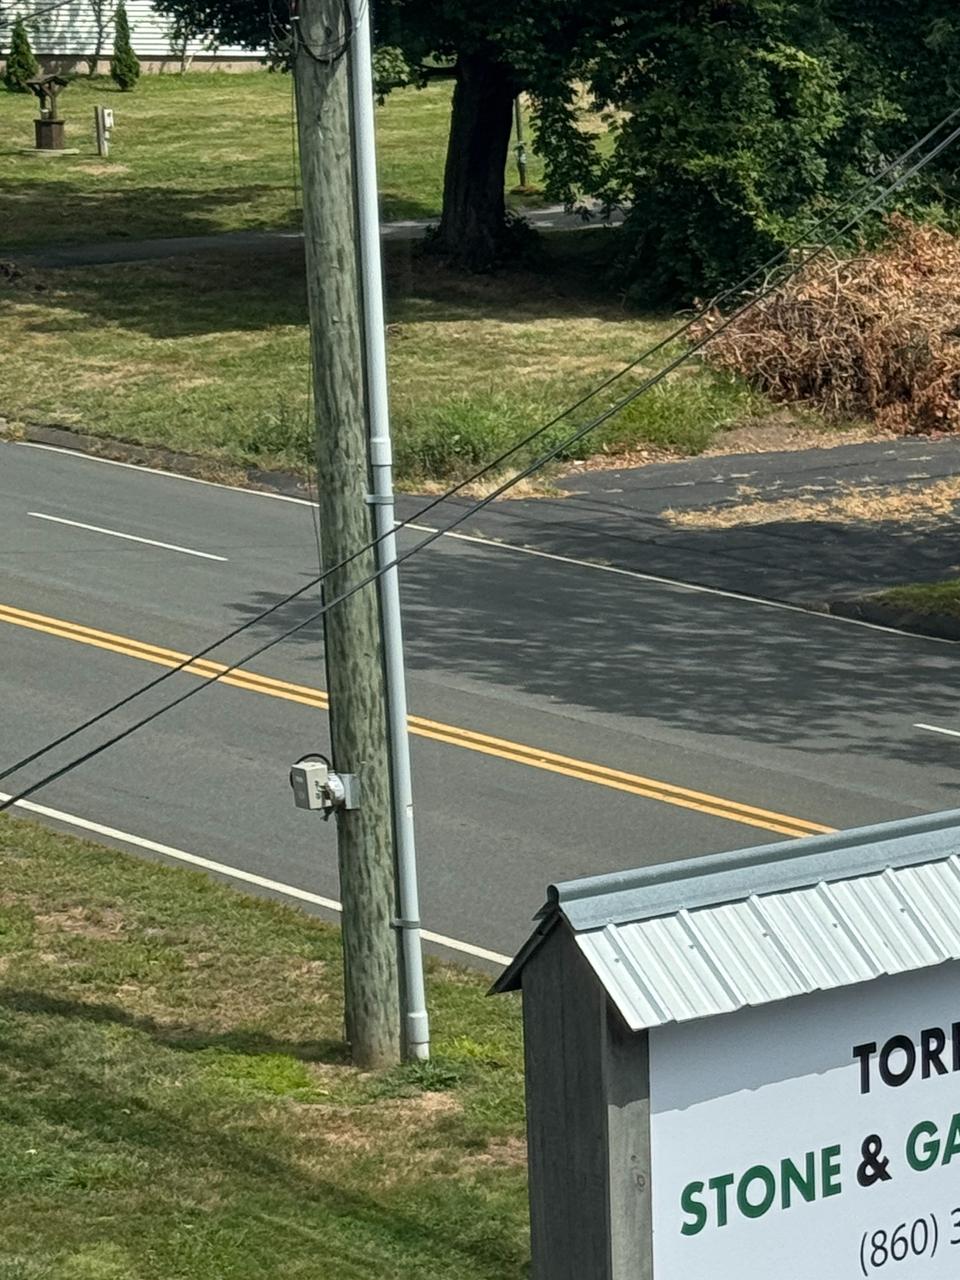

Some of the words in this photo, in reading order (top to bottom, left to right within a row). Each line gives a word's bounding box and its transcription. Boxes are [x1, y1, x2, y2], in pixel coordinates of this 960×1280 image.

[680, 1144, 842, 1236] STONE
[856, 1133, 892, 1187] &
[859, 1212, 939, 1277] (860)
